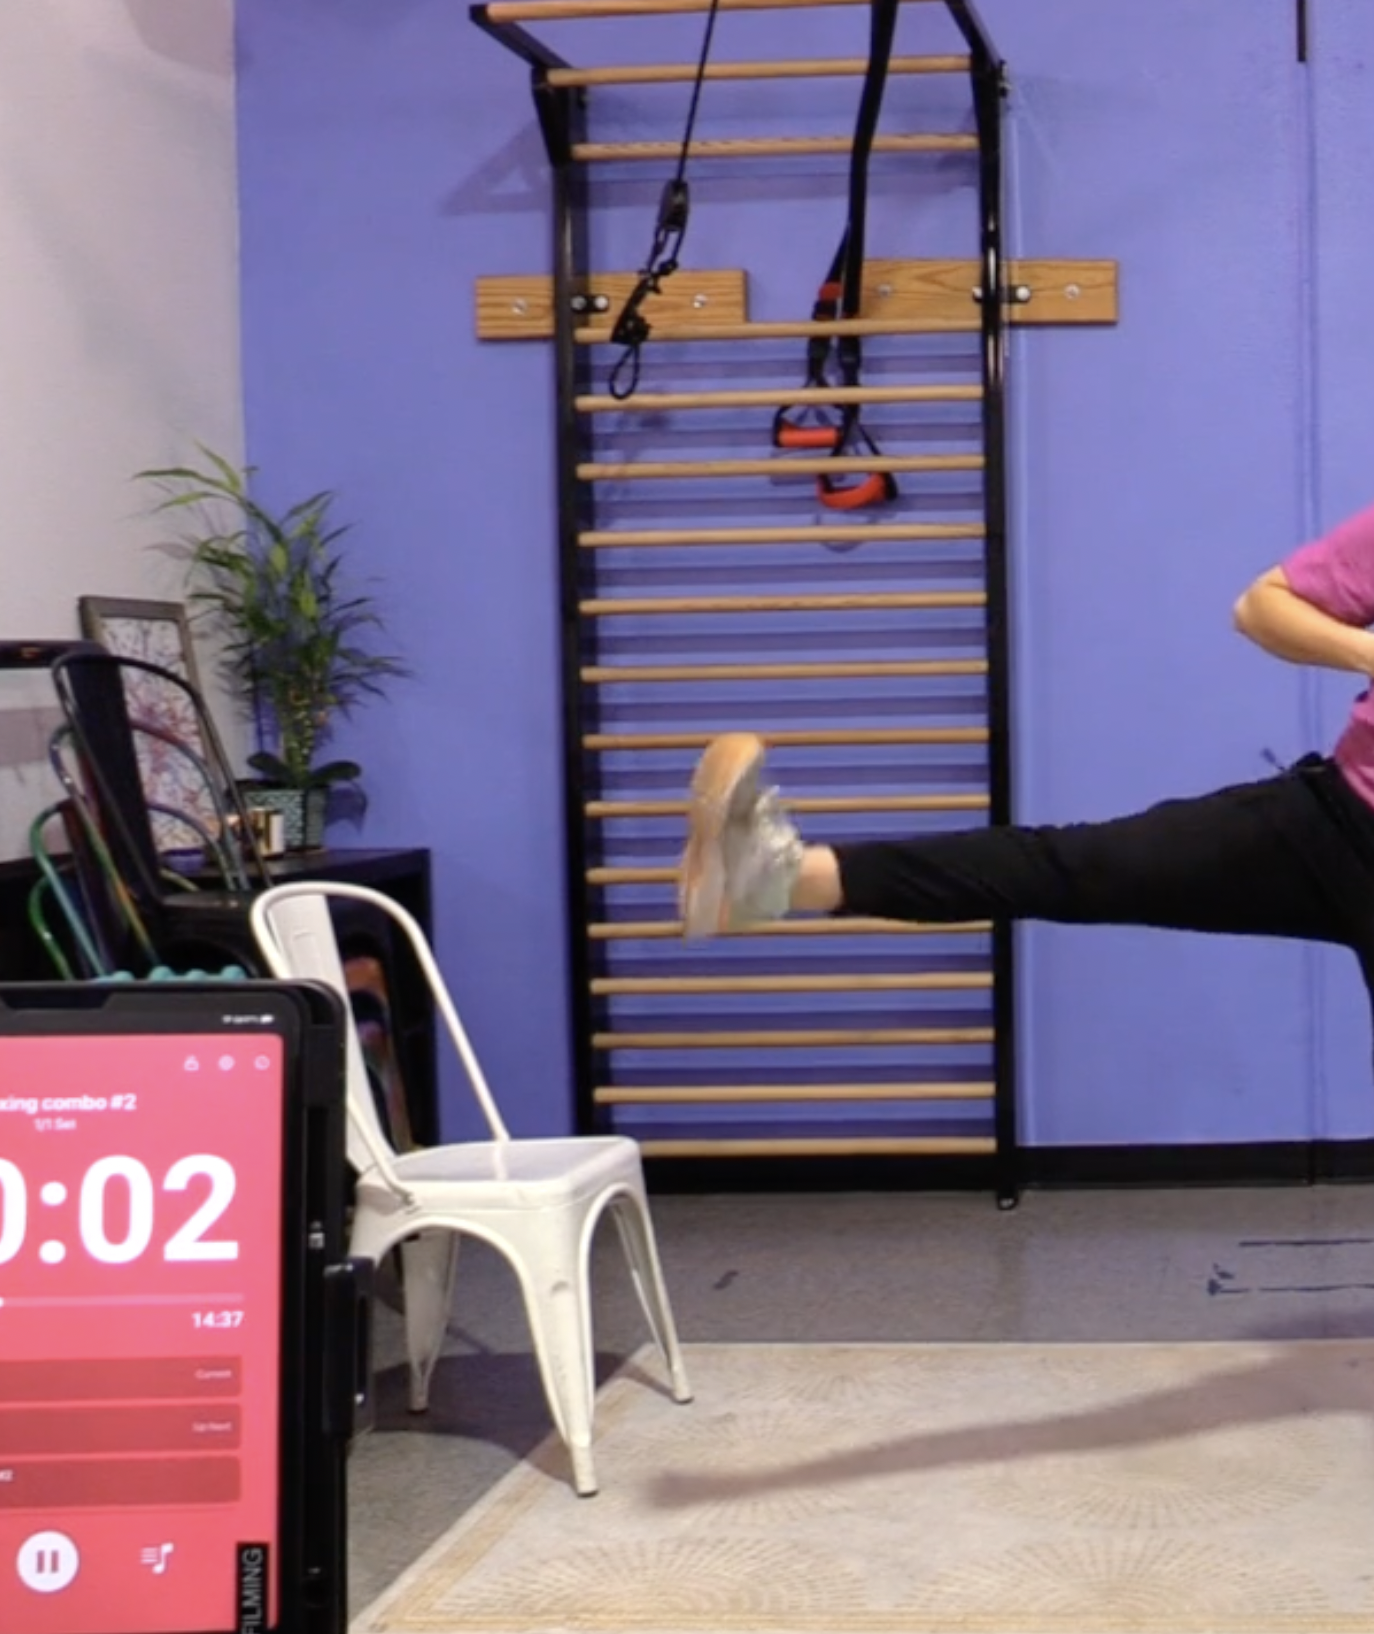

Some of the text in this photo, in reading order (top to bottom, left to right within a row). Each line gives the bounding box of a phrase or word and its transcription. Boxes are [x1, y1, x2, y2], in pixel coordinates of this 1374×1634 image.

[42, 1094, 107, 1112] combo
[110, 1093, 138, 1112] #2
[192, 1310, 244, 1328] 14:37
[241, 1547, 263, 1634] FILMING
